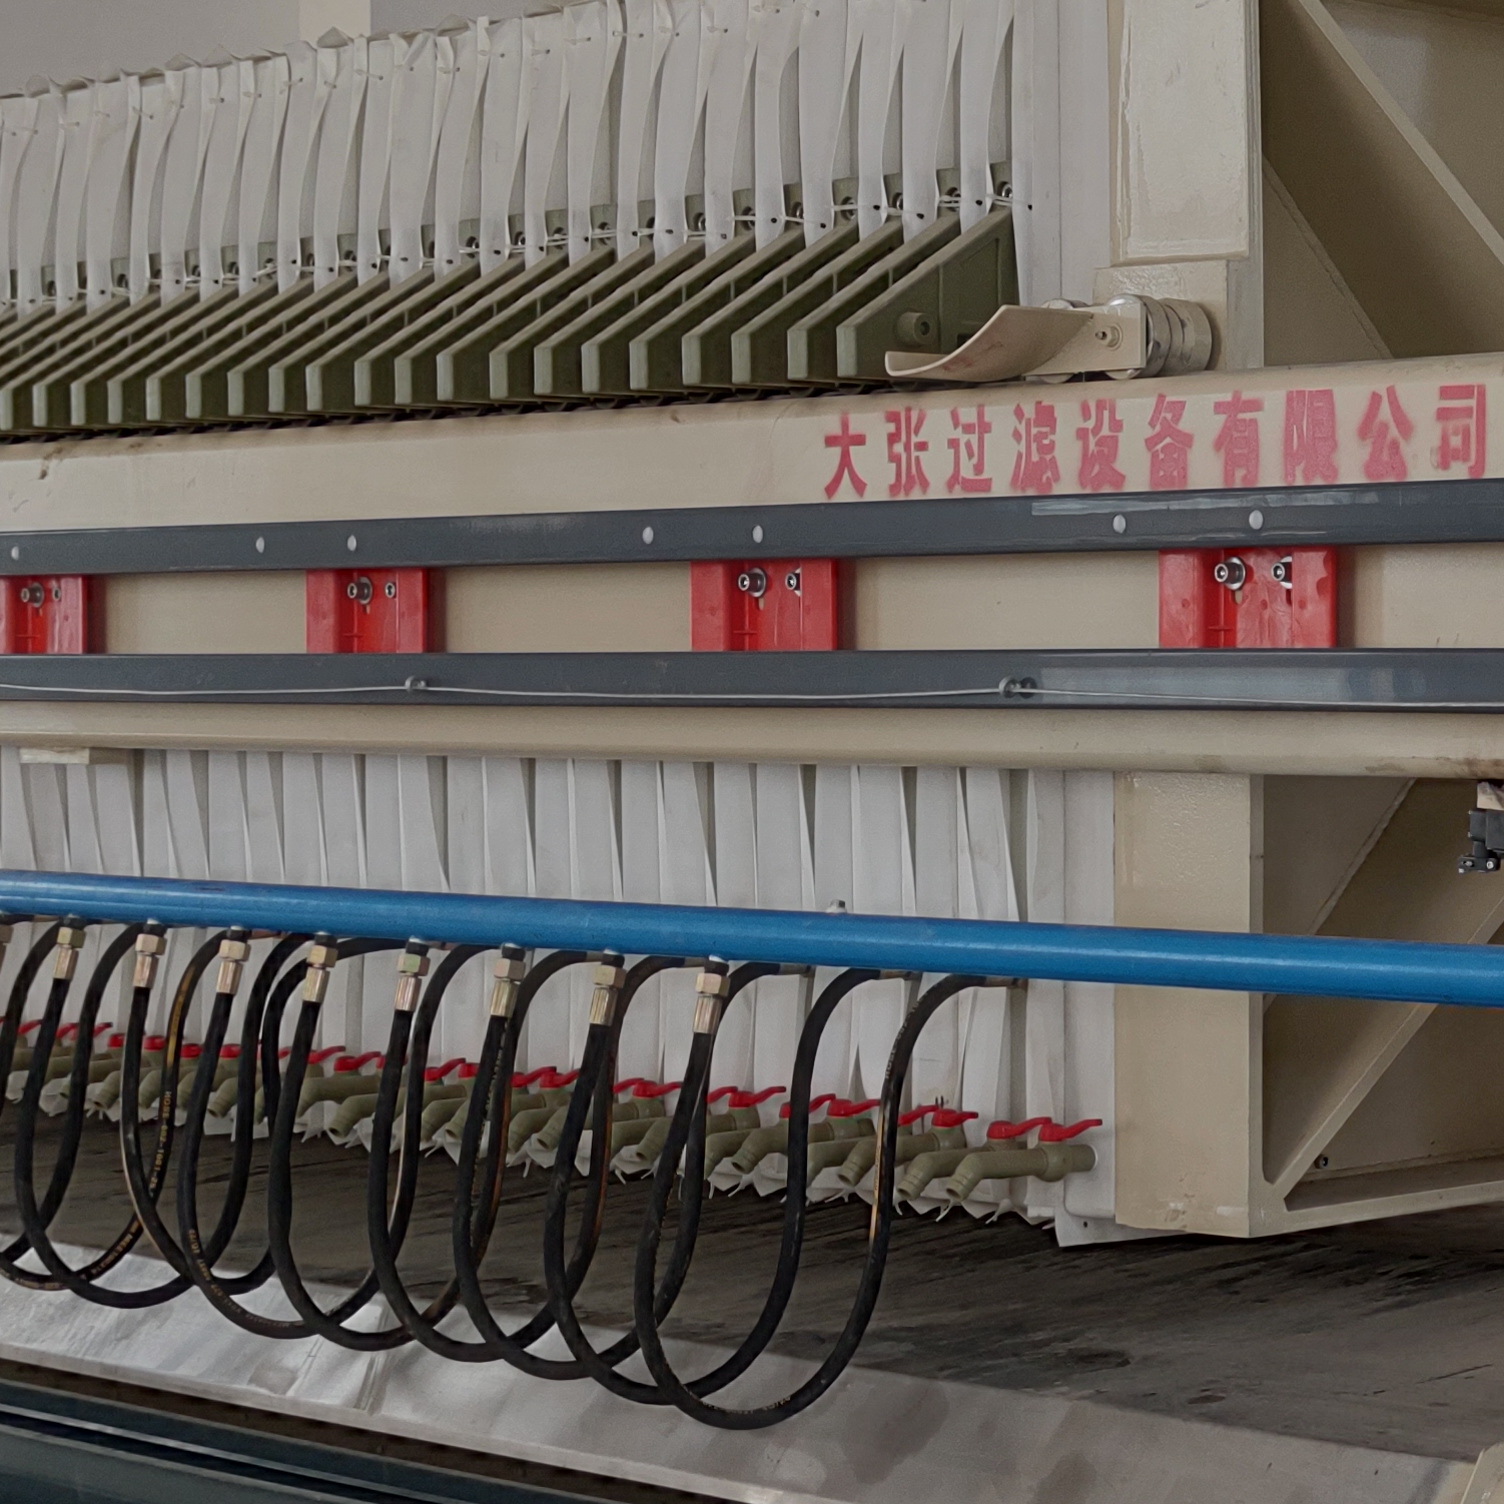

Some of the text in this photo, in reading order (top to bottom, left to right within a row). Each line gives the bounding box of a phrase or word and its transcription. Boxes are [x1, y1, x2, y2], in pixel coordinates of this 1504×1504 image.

[824, 382, 1487, 499] 大张过滤设备有限公司
